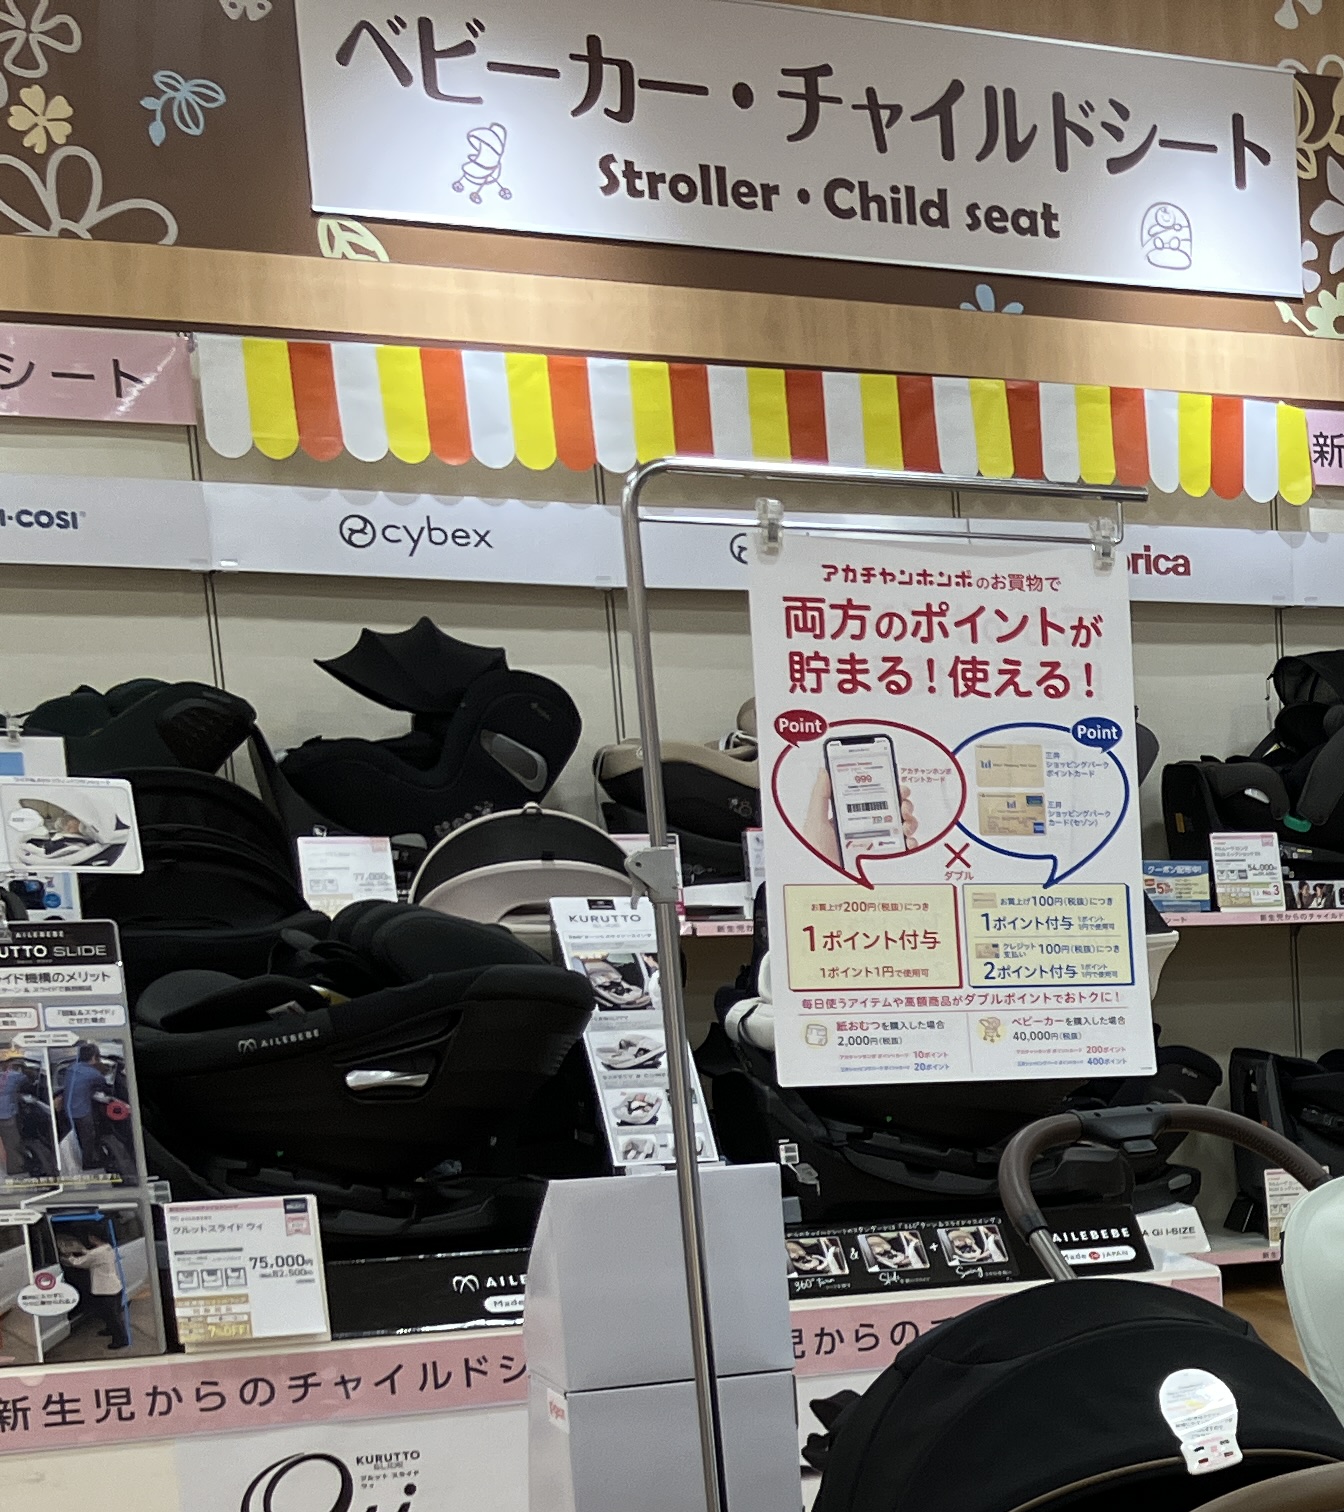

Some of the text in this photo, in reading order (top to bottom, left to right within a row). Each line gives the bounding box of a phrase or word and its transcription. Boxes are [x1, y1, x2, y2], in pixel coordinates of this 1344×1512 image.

[336, 15, 1271, 190] ベビーカー・チャイルドシート
[599, 155, 1061, 240] Stroller Child seat
[382, 519, 494, 557] cybex
[782, 596, 1104, 648] 両方のポイントが
[778, 717, 824, 734] Point
[1076, 724, 1119, 741] Point
[944, 870, 975, 881] ダブル
[568, 913, 642, 925] KURUTTO
[980, 912, 1075, 932] 1ポイント付与
[802, 925, 942, 953] 1ポイント付与
[53, 944, 108, 957] SLIDE
[983, 961, 1079, 981] 2ポイント付与
[1053, 1227, 1131, 1243] AILEBEBE
[355, 1450, 421, 1467] KURUTTO
